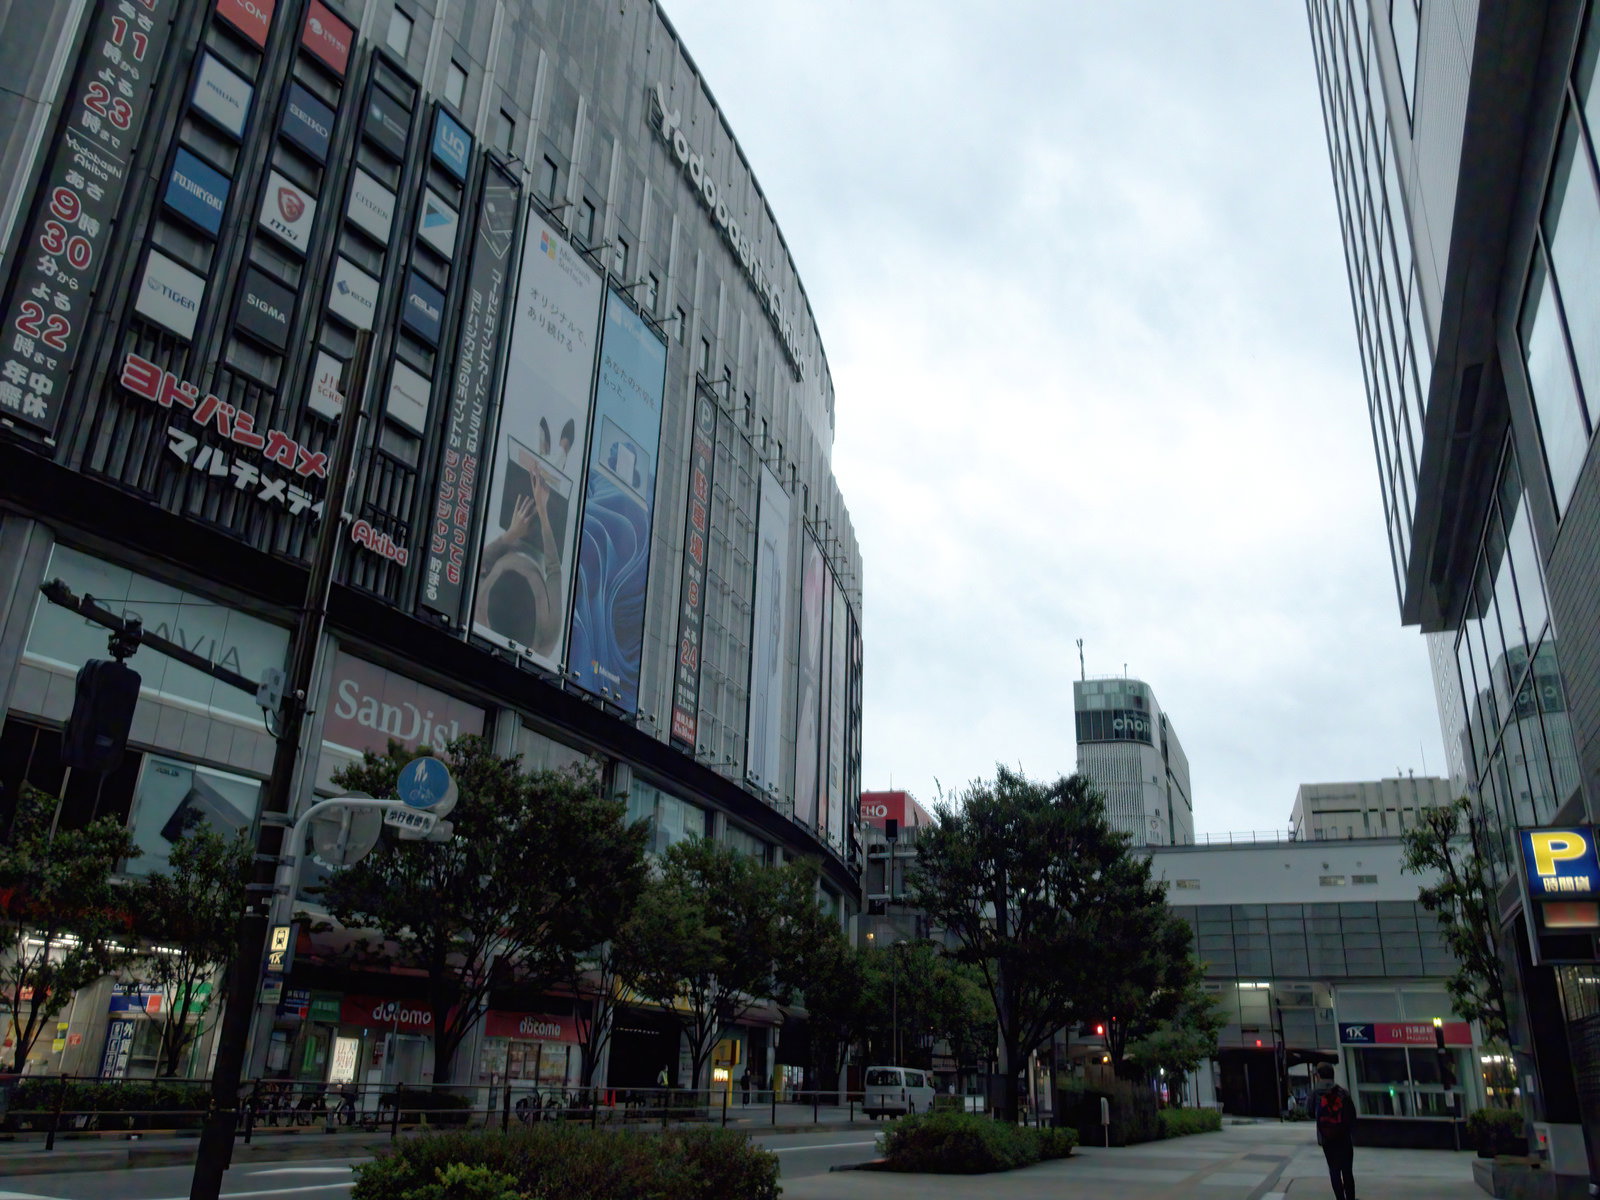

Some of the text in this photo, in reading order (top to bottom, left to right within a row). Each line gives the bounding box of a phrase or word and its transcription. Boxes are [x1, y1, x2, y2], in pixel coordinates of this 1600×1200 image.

[111, 15, 149, 62] 11
[98, 67, 134, 98] よる
[83, 80, 133, 130] 23
[289, 102, 328, 138] SEIKO
[65, 133, 124, 179] Yodobashi
[73, 153, 110, 183] Akiba
[65, 169, 105, 202] あさ
[355, 191, 389, 222] CITIZEN
[40, 221, 92, 271] 30
[31, 281, 71, 312] よる
[162, 285, 196, 312] TIGER
[246, 292, 286, 324] SIGMA
[409, 293, 439, 321] ASUS
[15, 300, 71, 352] 22
[527, 305, 574, 352] あり続ける
[2, 359, 54, 397] 年中
[0, 383, 48, 419] 無休
[120, 352, 356, 488] ヨドバシカメ
[167, 426, 352, 524] マルチメディ
[352, 519, 409, 567] Akiba
[680, 638, 697, 673] 24
[1530, 831, 1587, 877] P
[268, 951, 285, 965] TX
[372, 1001, 432, 1025] docomo
[1346, 1026, 1366, 1038] TX
